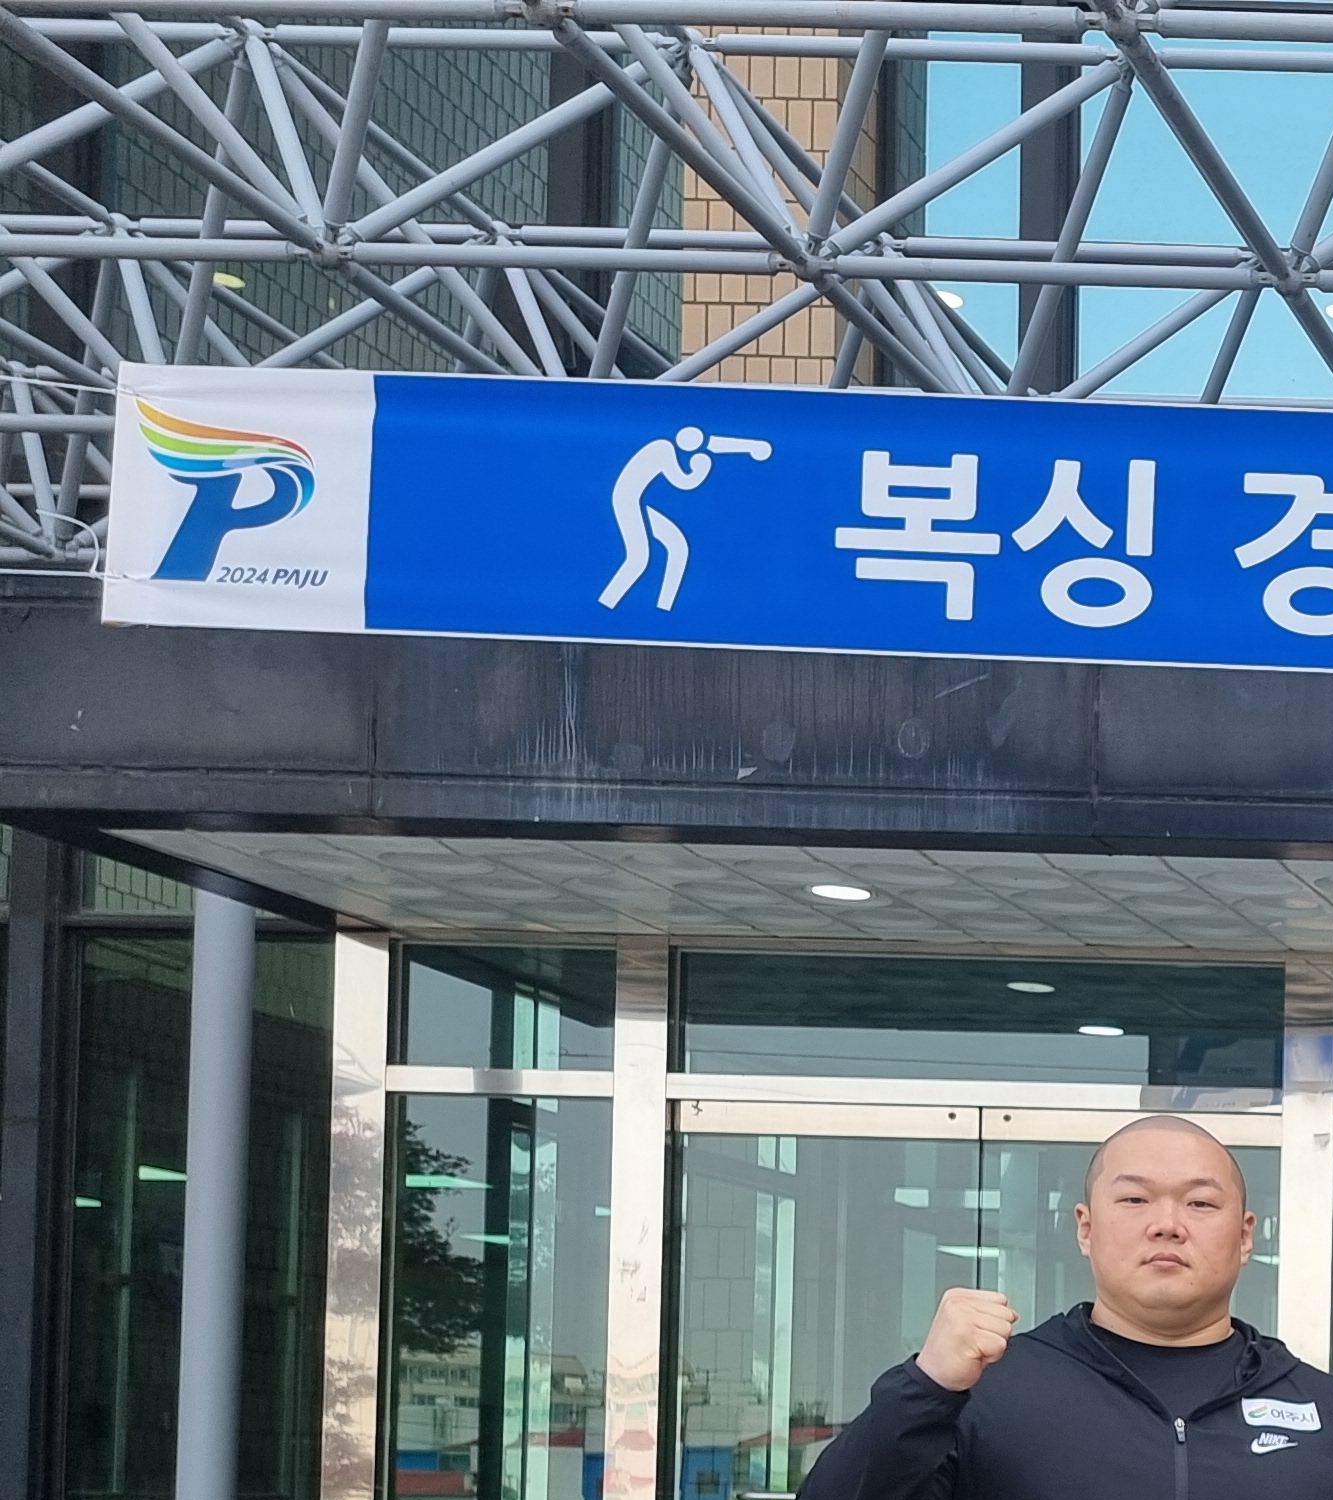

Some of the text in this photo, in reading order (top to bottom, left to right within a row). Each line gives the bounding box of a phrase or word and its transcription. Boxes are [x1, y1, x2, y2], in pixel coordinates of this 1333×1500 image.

[835, 450, 1156, 628] 복싱
[216, 566, 330, 590] 2024 PAJU
[1258, 1432, 1290, 1446] NIKE
